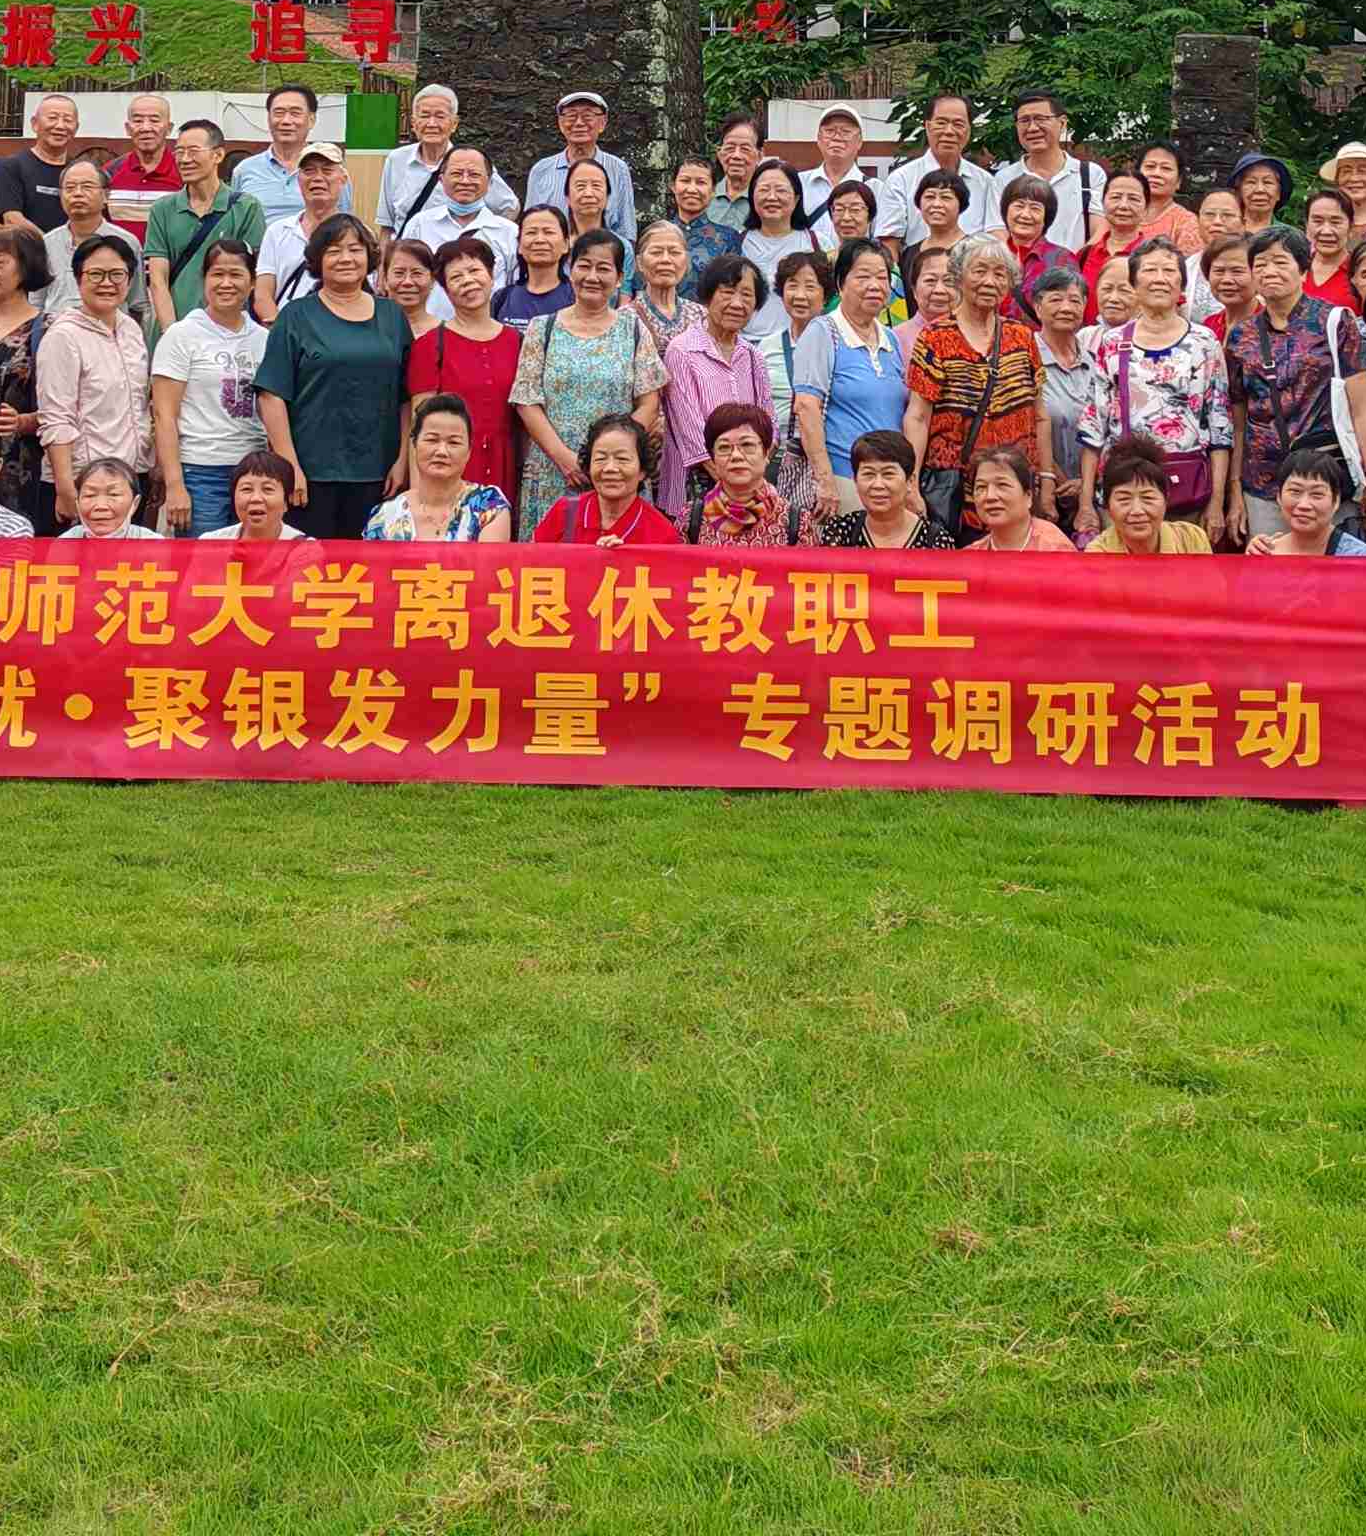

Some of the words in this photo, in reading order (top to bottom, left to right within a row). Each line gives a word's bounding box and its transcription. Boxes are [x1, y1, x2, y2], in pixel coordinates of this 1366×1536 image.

[722, 672, 1323, 769] 专题调研活动
